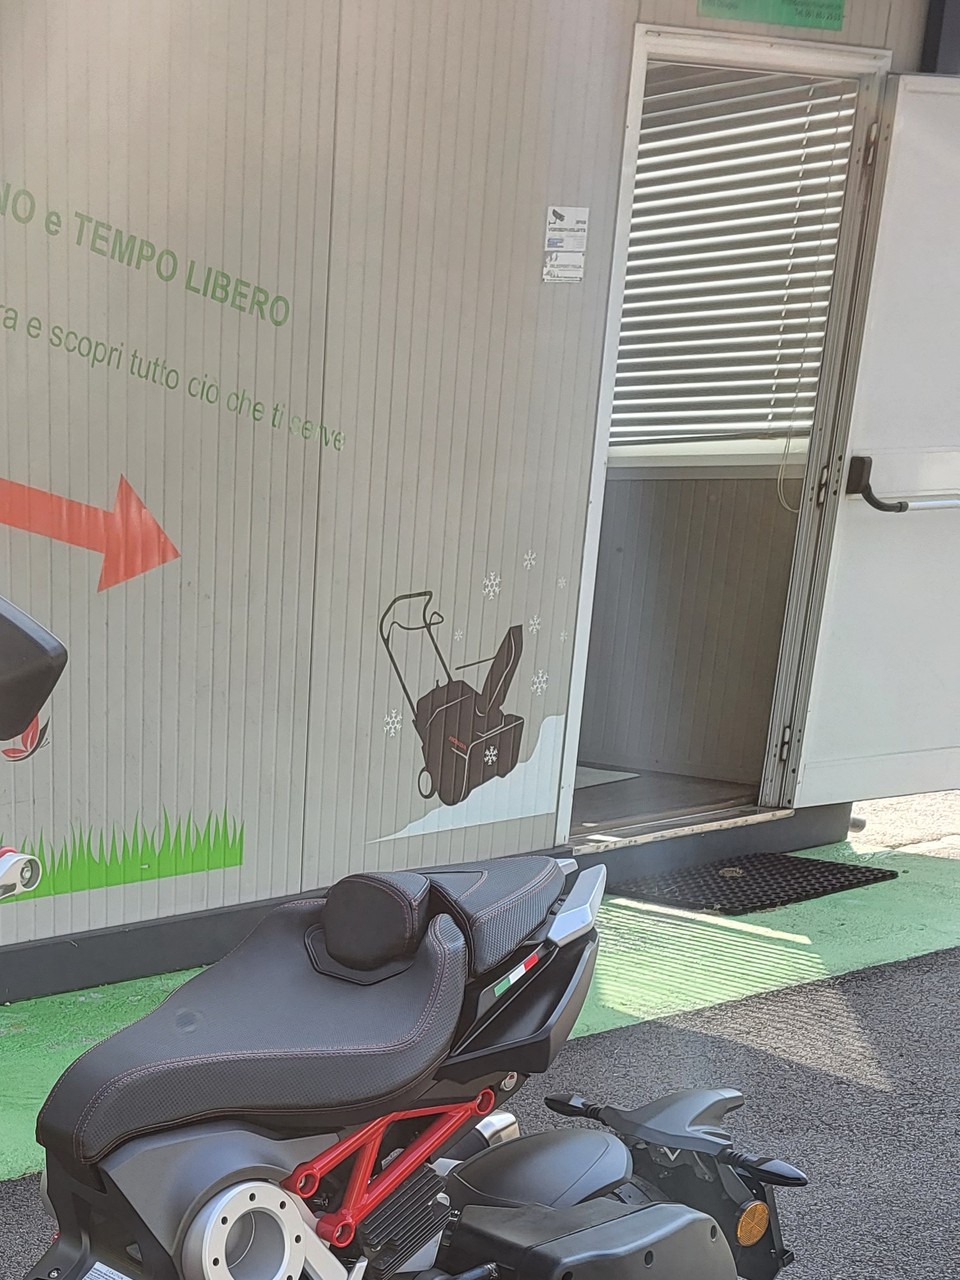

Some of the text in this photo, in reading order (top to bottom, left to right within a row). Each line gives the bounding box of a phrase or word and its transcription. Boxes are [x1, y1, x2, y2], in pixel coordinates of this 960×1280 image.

[45, 210, 62, 236] e
[74, 211, 178, 282] TEMPO
[185, 259, 290, 327] LIBERO
[26, 316, 42, 339] e
[49, 325, 124, 369] scopri
[129, 349, 179, 390] tutto
[226, 389, 266, 422] che
[271, 402, 286, 430] ti
